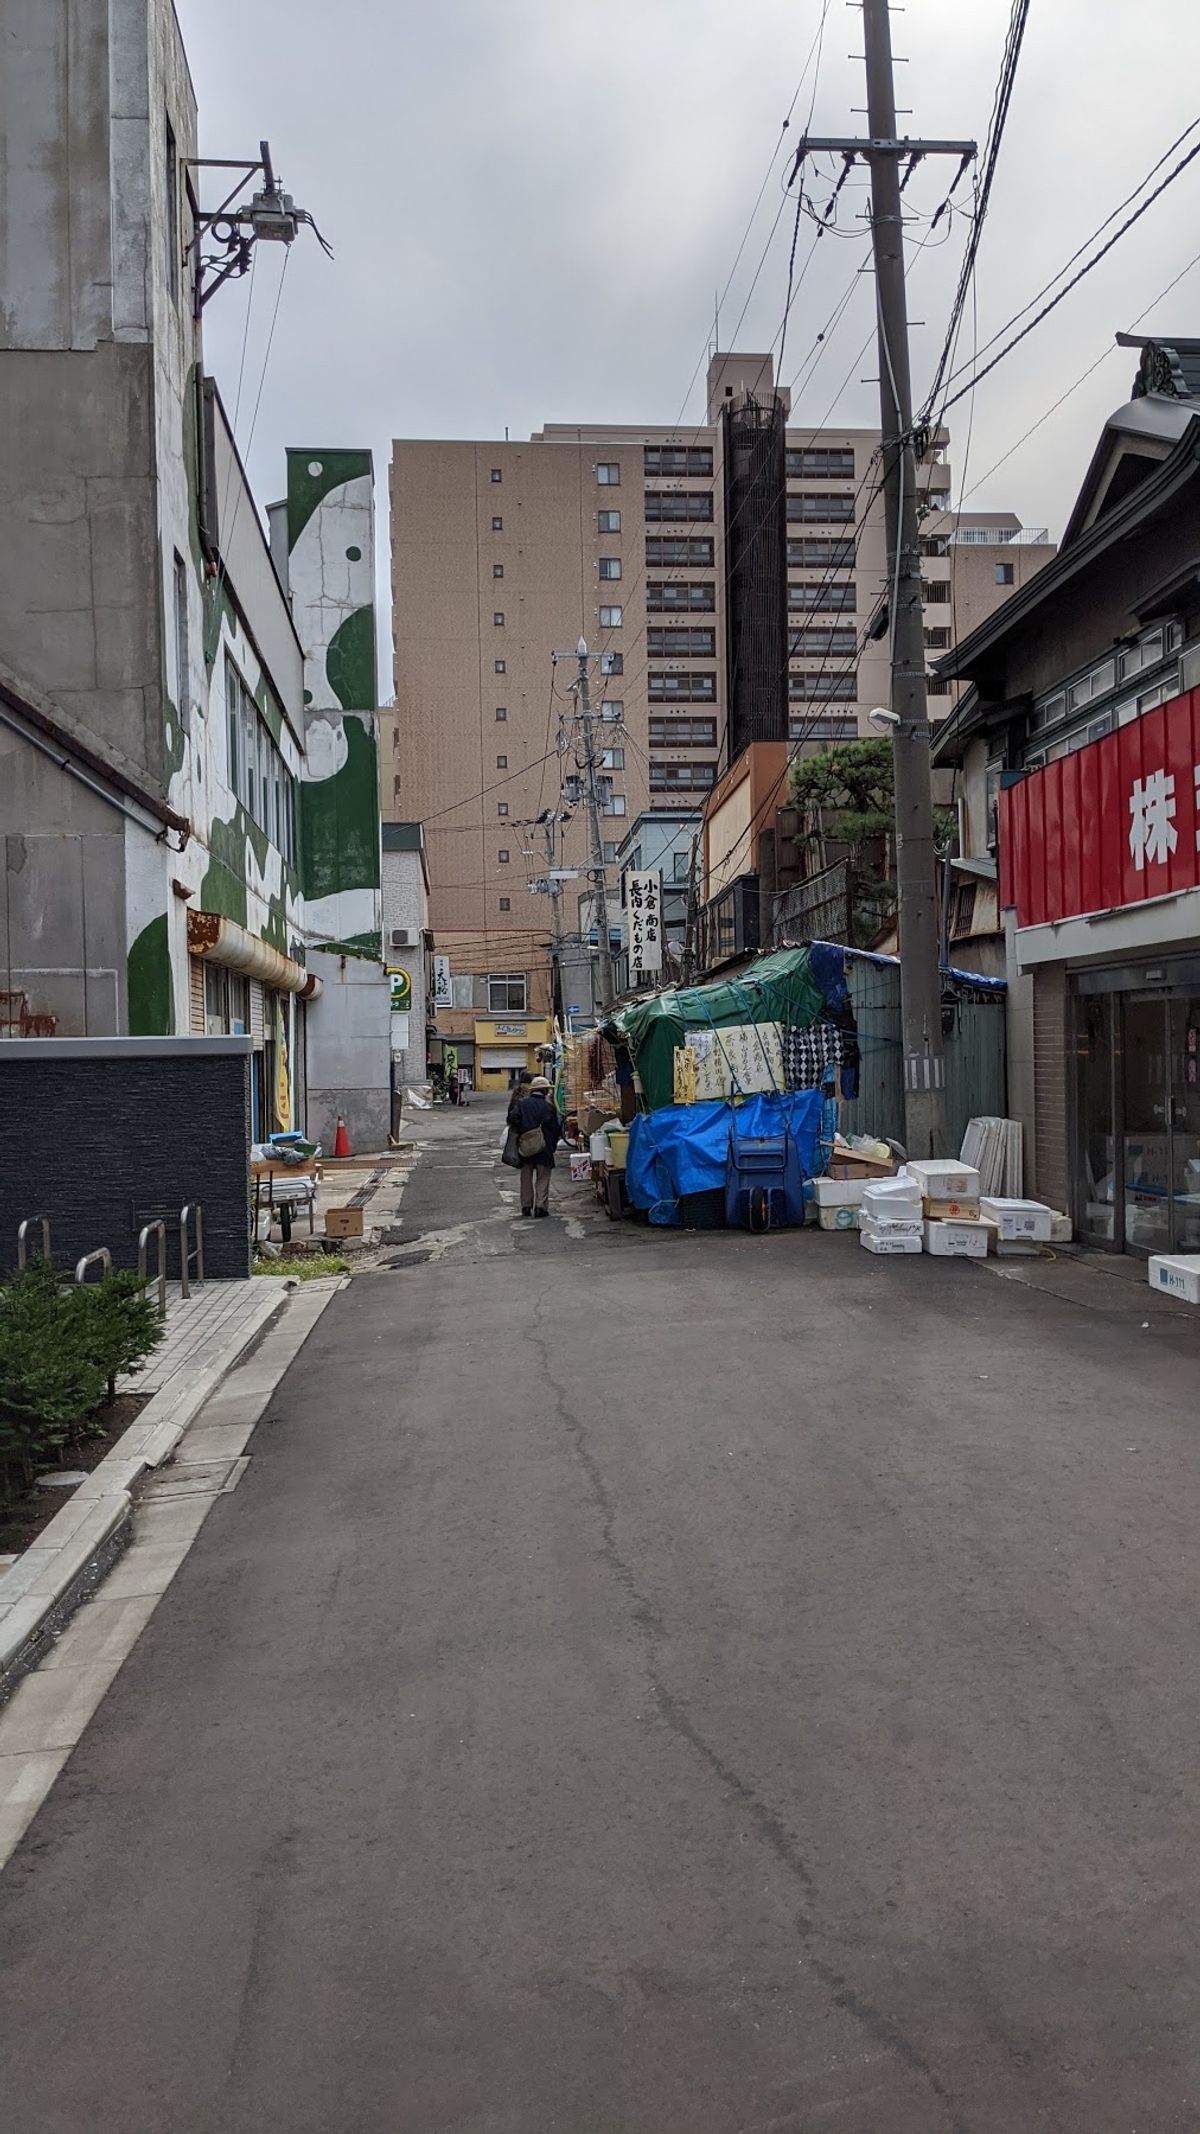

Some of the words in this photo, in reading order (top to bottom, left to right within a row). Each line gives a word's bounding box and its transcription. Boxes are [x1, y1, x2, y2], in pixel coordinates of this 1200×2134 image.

[1129, 765, 1200, 871] 株
[629, 879, 643, 968] 長内くだもの店
[644, 879, 658, 941] 小倉商店
[1169, 1274, 1185, 1290] H-111
